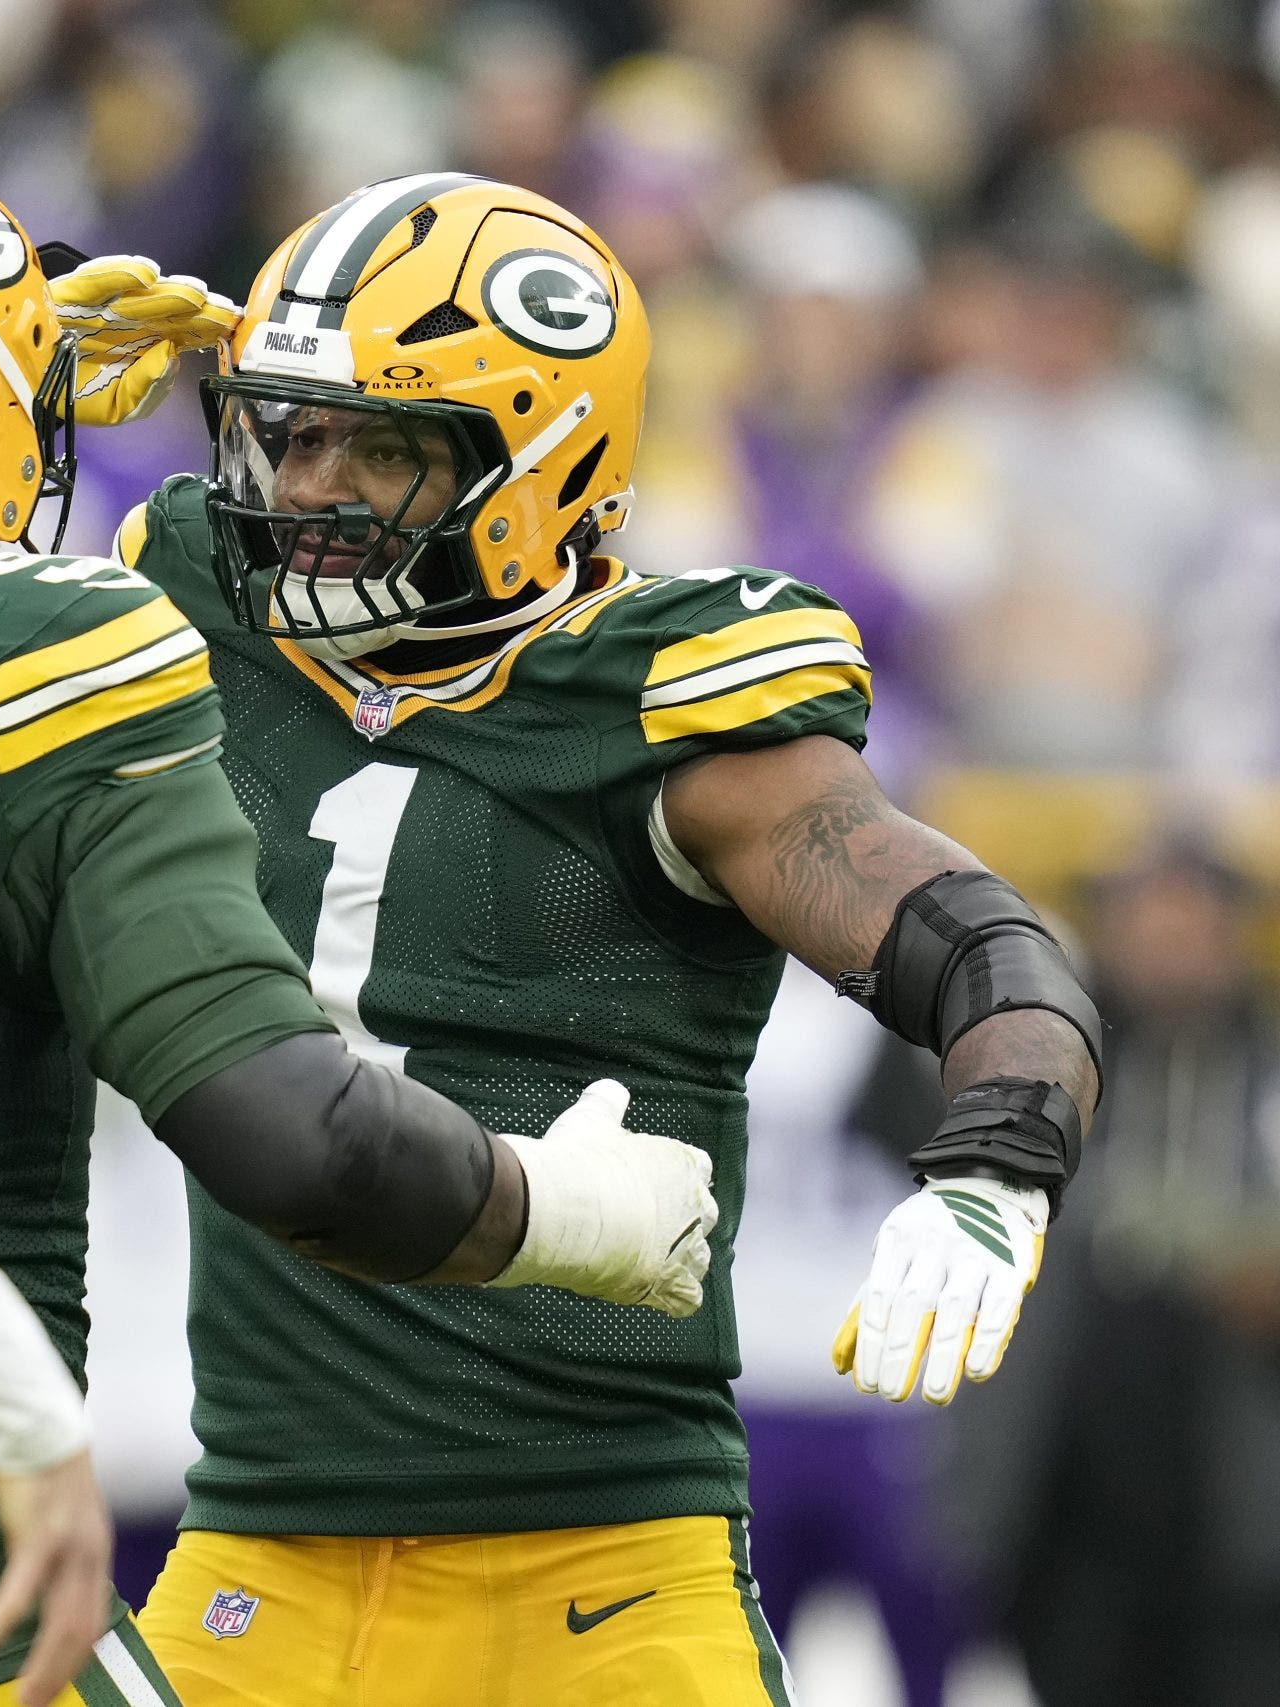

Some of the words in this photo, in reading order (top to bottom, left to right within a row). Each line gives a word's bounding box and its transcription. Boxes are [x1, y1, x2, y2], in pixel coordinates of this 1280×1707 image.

[489, 255, 613, 351] G
[372, 381, 434, 390] OAKLEY
[358, 705, 385, 730] NFL
[307, 762, 419, 1076] 1
[210, 1608, 241, 1630] NFL
